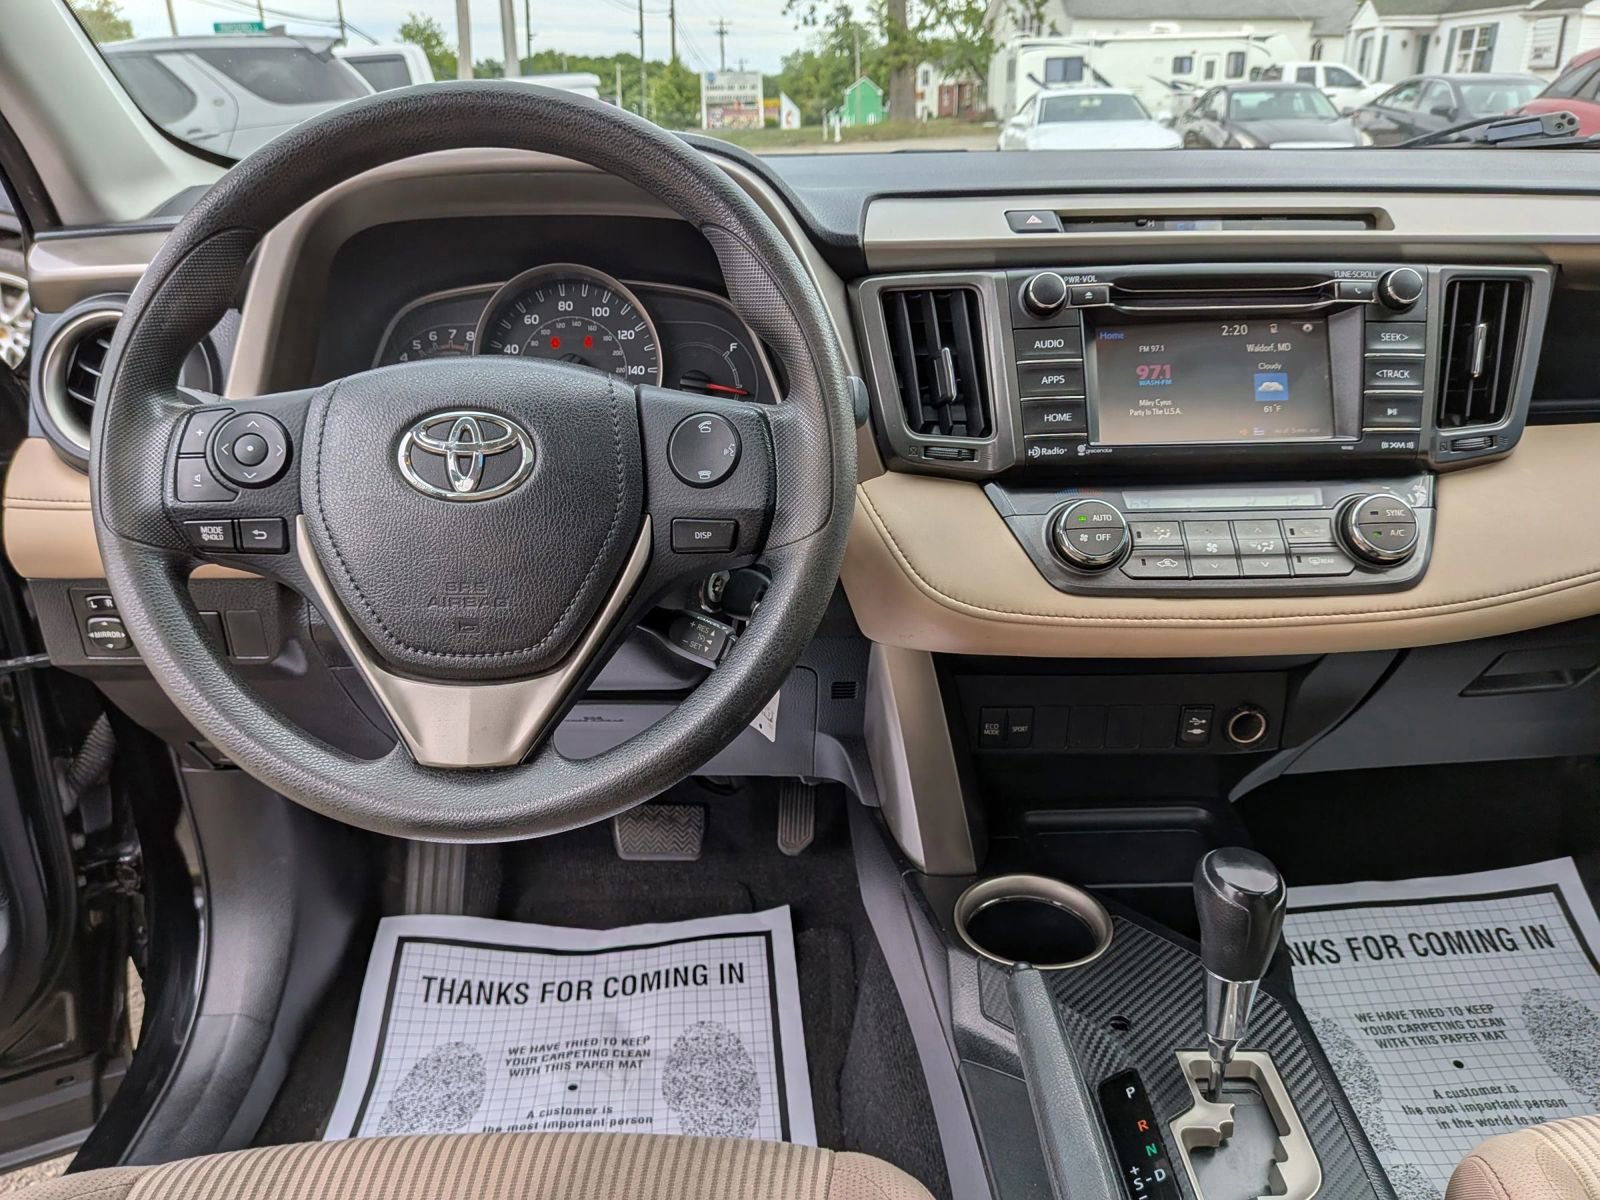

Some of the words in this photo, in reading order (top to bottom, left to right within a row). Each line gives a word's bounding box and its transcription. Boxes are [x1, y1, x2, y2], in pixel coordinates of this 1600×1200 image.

[558, 300, 574, 311] 80
[591, 306, 610, 317] 100
[524, 314, 539, 325] 60
[448, 329, 457, 339] 7
[617, 330, 635, 340] 120
[1099, 331, 1125, 340] Home
[1221, 324, 1249, 336] 2:20
[428, 331, 438, 342] 6
[466, 331, 475, 342] 8
[412, 340, 421, 350] 5
[504, 344, 520, 354] 40
[730, 342, 738, 352] F
[1034, 338, 1064, 349] AUDIO
[1277, 342, 1292, 352] MD
[400, 352, 408, 362] 4
[628, 365, 645, 375] 140
[1258, 362, 1282, 370] Cloudy
[1041, 375, 1065, 384] APPS
[1044, 412, 1072, 422] HOME
[1129, 408, 1145, 416] Party
[1092, 514, 1112, 522] AUTO
[1385, 509, 1406, 517] SYNC
[200, 526, 223, 534] MODE
[694, 531, 712, 540] DISP
[1389, 528, 1405, 537] A/C
[1095, 533, 1112, 541] OFF
[90, 600, 98, 608] L
[94, 630, 122, 639] MIRROR
[689, 640, 703, 650] SET
[1286, 938, 1341, 967] NKS
[1345, 935, 1406, 962] FOR
[1407, 926, 1520, 957] COMING
[1519, 924, 1556, 950] IN
[422, 975, 531, 1006] THANKS
[540, 979, 594, 1004] FOR
[603, 963, 709, 999] COMING
[719, 962, 745, 985] IN
[1354, 1011, 1376, 1023] WE
[1375, 1009, 1409, 1022] HAVE
[1408, 1007, 1446, 1020] TRIED
[1446, 1006, 1464, 1017] TO
[1464, 1003, 1495, 1015] KEEP
[1360, 1025, 1397, 1037] YOUR
[1397, 1019, 1465, 1035] CARPETING
[1465, 1016, 1507, 1030] CLEAN
[1375, 1037, 1409, 1049] WITH
[1408, 1034, 1439, 1047] THIS
[1440, 1031, 1481, 1045] PAPER
[1480, 1030, 1509, 1041] MAT
[508, 1045, 526, 1057] WE
[529, 1041, 560, 1054] HAVE
[565, 1038, 599, 1050] TRIED
[602, 1037, 617, 1047] TO
[621, 1035, 651, 1047] KEEP
[505, 1055, 538, 1067] YOUR
[541, 1048, 609, 1062] CARPETING
[612, 1048, 651, 1059] CLEAN
[509, 1067, 541, 1078] WITH
[545, 1061, 572, 1073] THIS
[575, 1059, 614, 1070] PAPER
[618, 1059, 644, 1069] MAT
[1126, 1087, 1135, 1099] P
[1433, 1088, 1443, 1100] A
[1445, 1084, 1502, 1099] customer
[1505, 1083, 1519, 1094] is
[526, 1110, 535, 1119] A
[539, 1106, 597, 1118] customer
[602, 1105, 613, 1114] is
[1402, 1104, 1423, 1116] the
[1426, 1103, 1457, 1115] most
[1461, 1099, 1522, 1114] important
[1523, 1098, 1568, 1111] person
[507, 1122, 538, 1132] most
[543, 1118, 605, 1131] important
[609, 1116, 653, 1128] person
[1137, 1120, 1149, 1132] R
[1435, 1119, 1451, 1130] in
[1453, 1116, 1473, 1128] the
[1475, 1115, 1513, 1128] world
[1513, 1114, 1528, 1125] to
[1146, 1143, 1157, 1156] N
[1134, 1178, 1144, 1190] S
[1154, 1169, 1166, 1181] D
